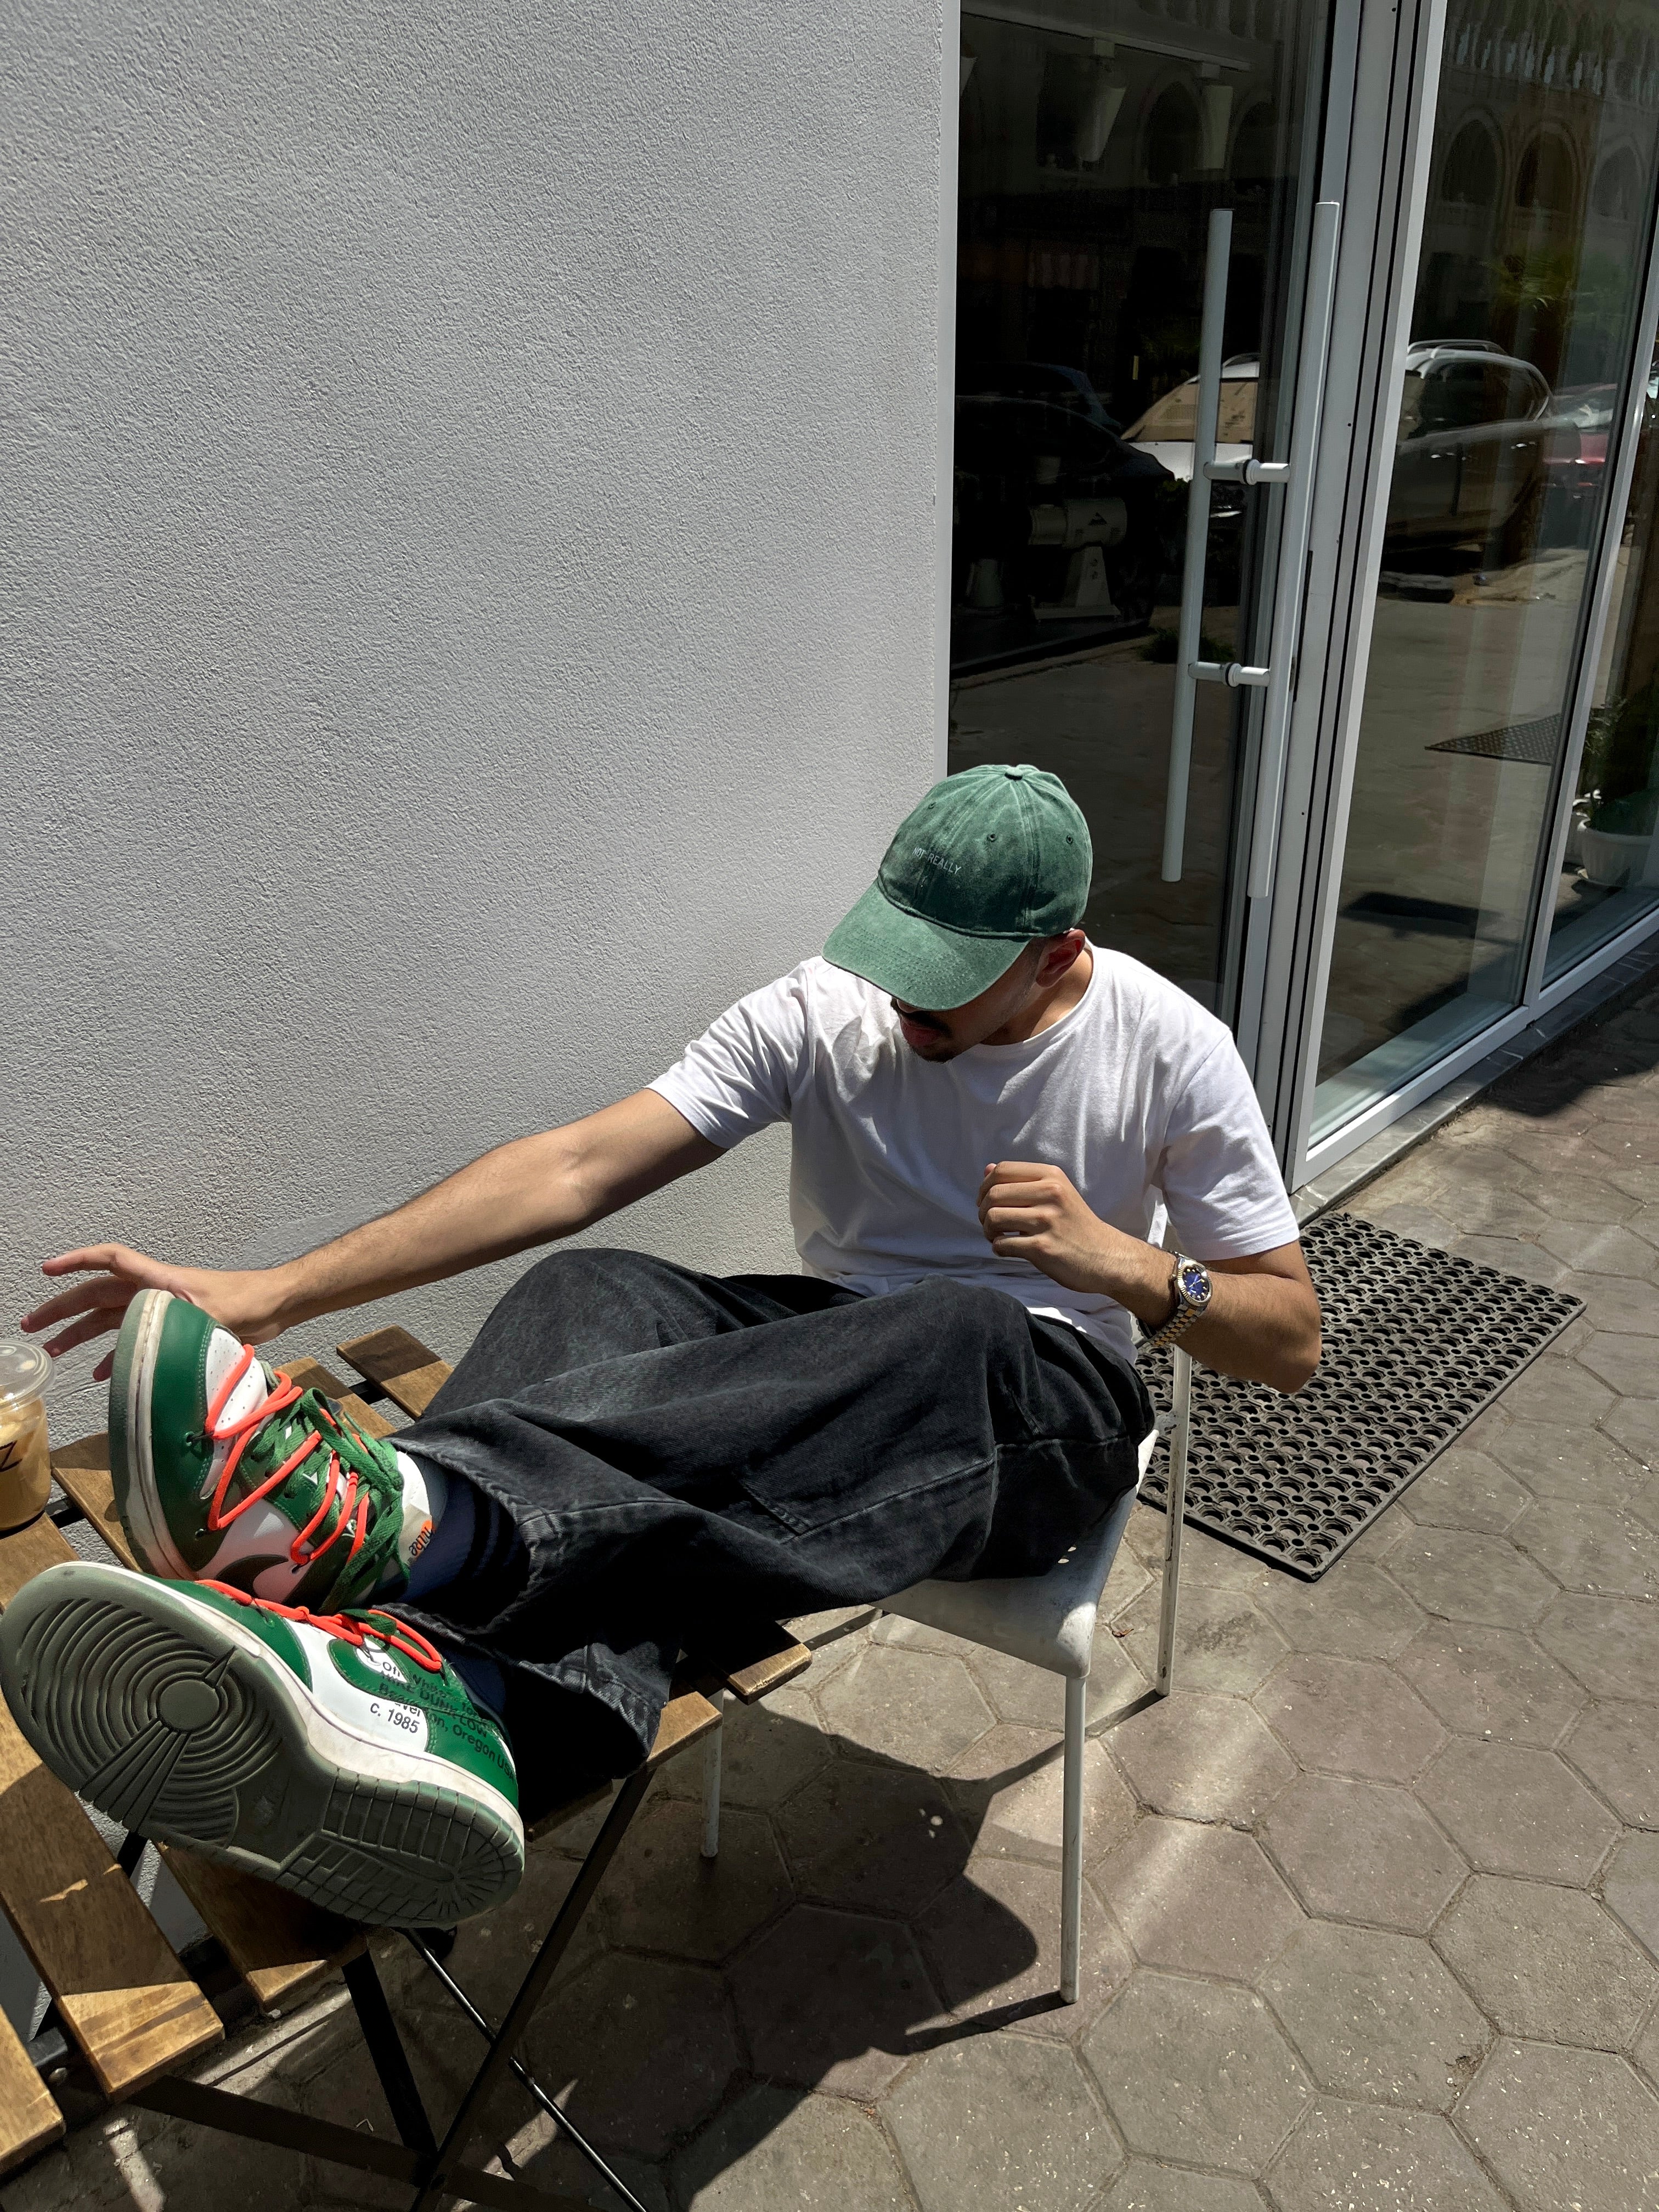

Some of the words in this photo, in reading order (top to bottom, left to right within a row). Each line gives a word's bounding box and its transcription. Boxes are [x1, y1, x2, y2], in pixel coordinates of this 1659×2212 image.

[912, 847, 926, 860] NOT
[927, 853, 962, 875] REALLY
[370, 1702, 381, 1717] c.
[388, 1708, 420, 1734] 1985
[453, 1724, 495, 1760] Oregon
